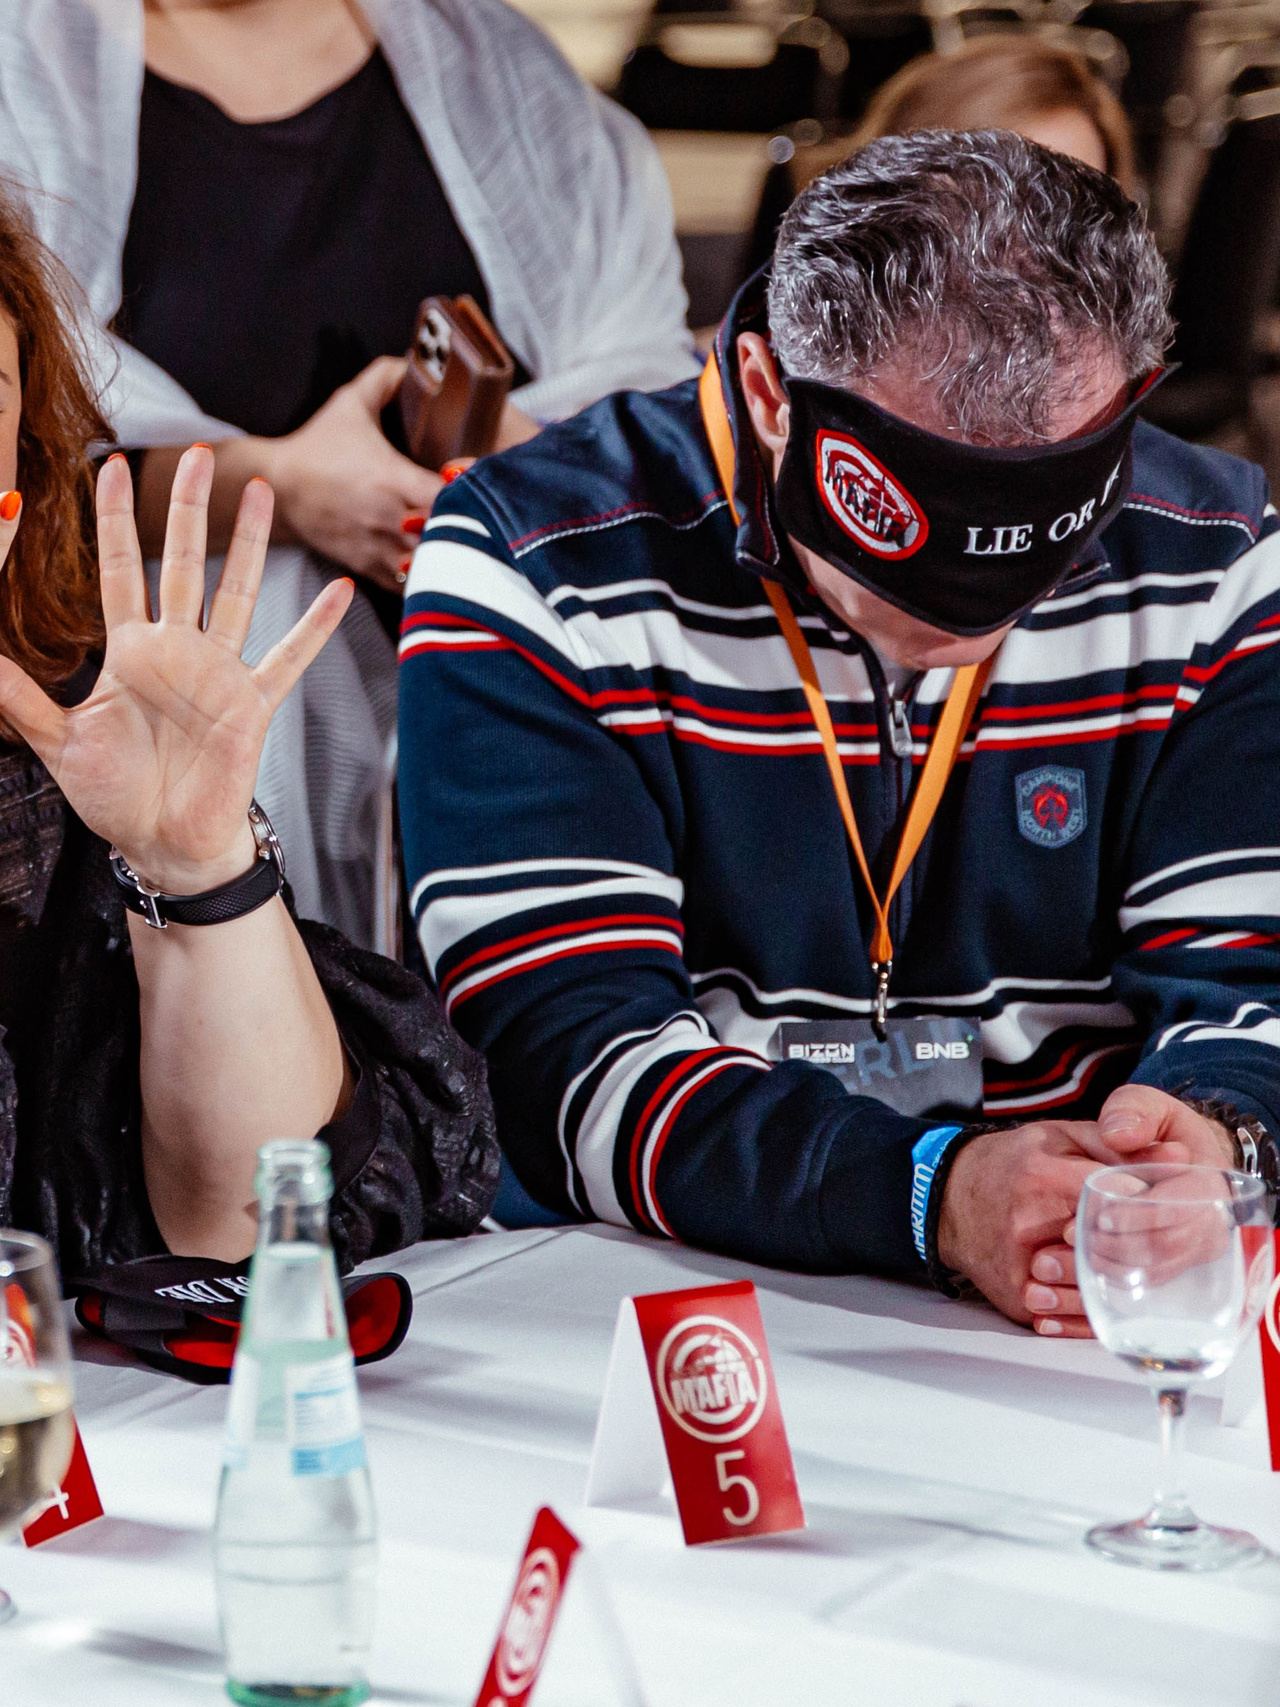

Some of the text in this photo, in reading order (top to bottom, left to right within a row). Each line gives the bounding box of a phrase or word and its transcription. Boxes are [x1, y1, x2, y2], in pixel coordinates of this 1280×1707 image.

[963, 497, 1096, 555] LIE OR
[915, 1042, 970, 1060] BNB
[671, 1371, 758, 1415] MAFIA
[715, 1449, 760, 1527] 5
